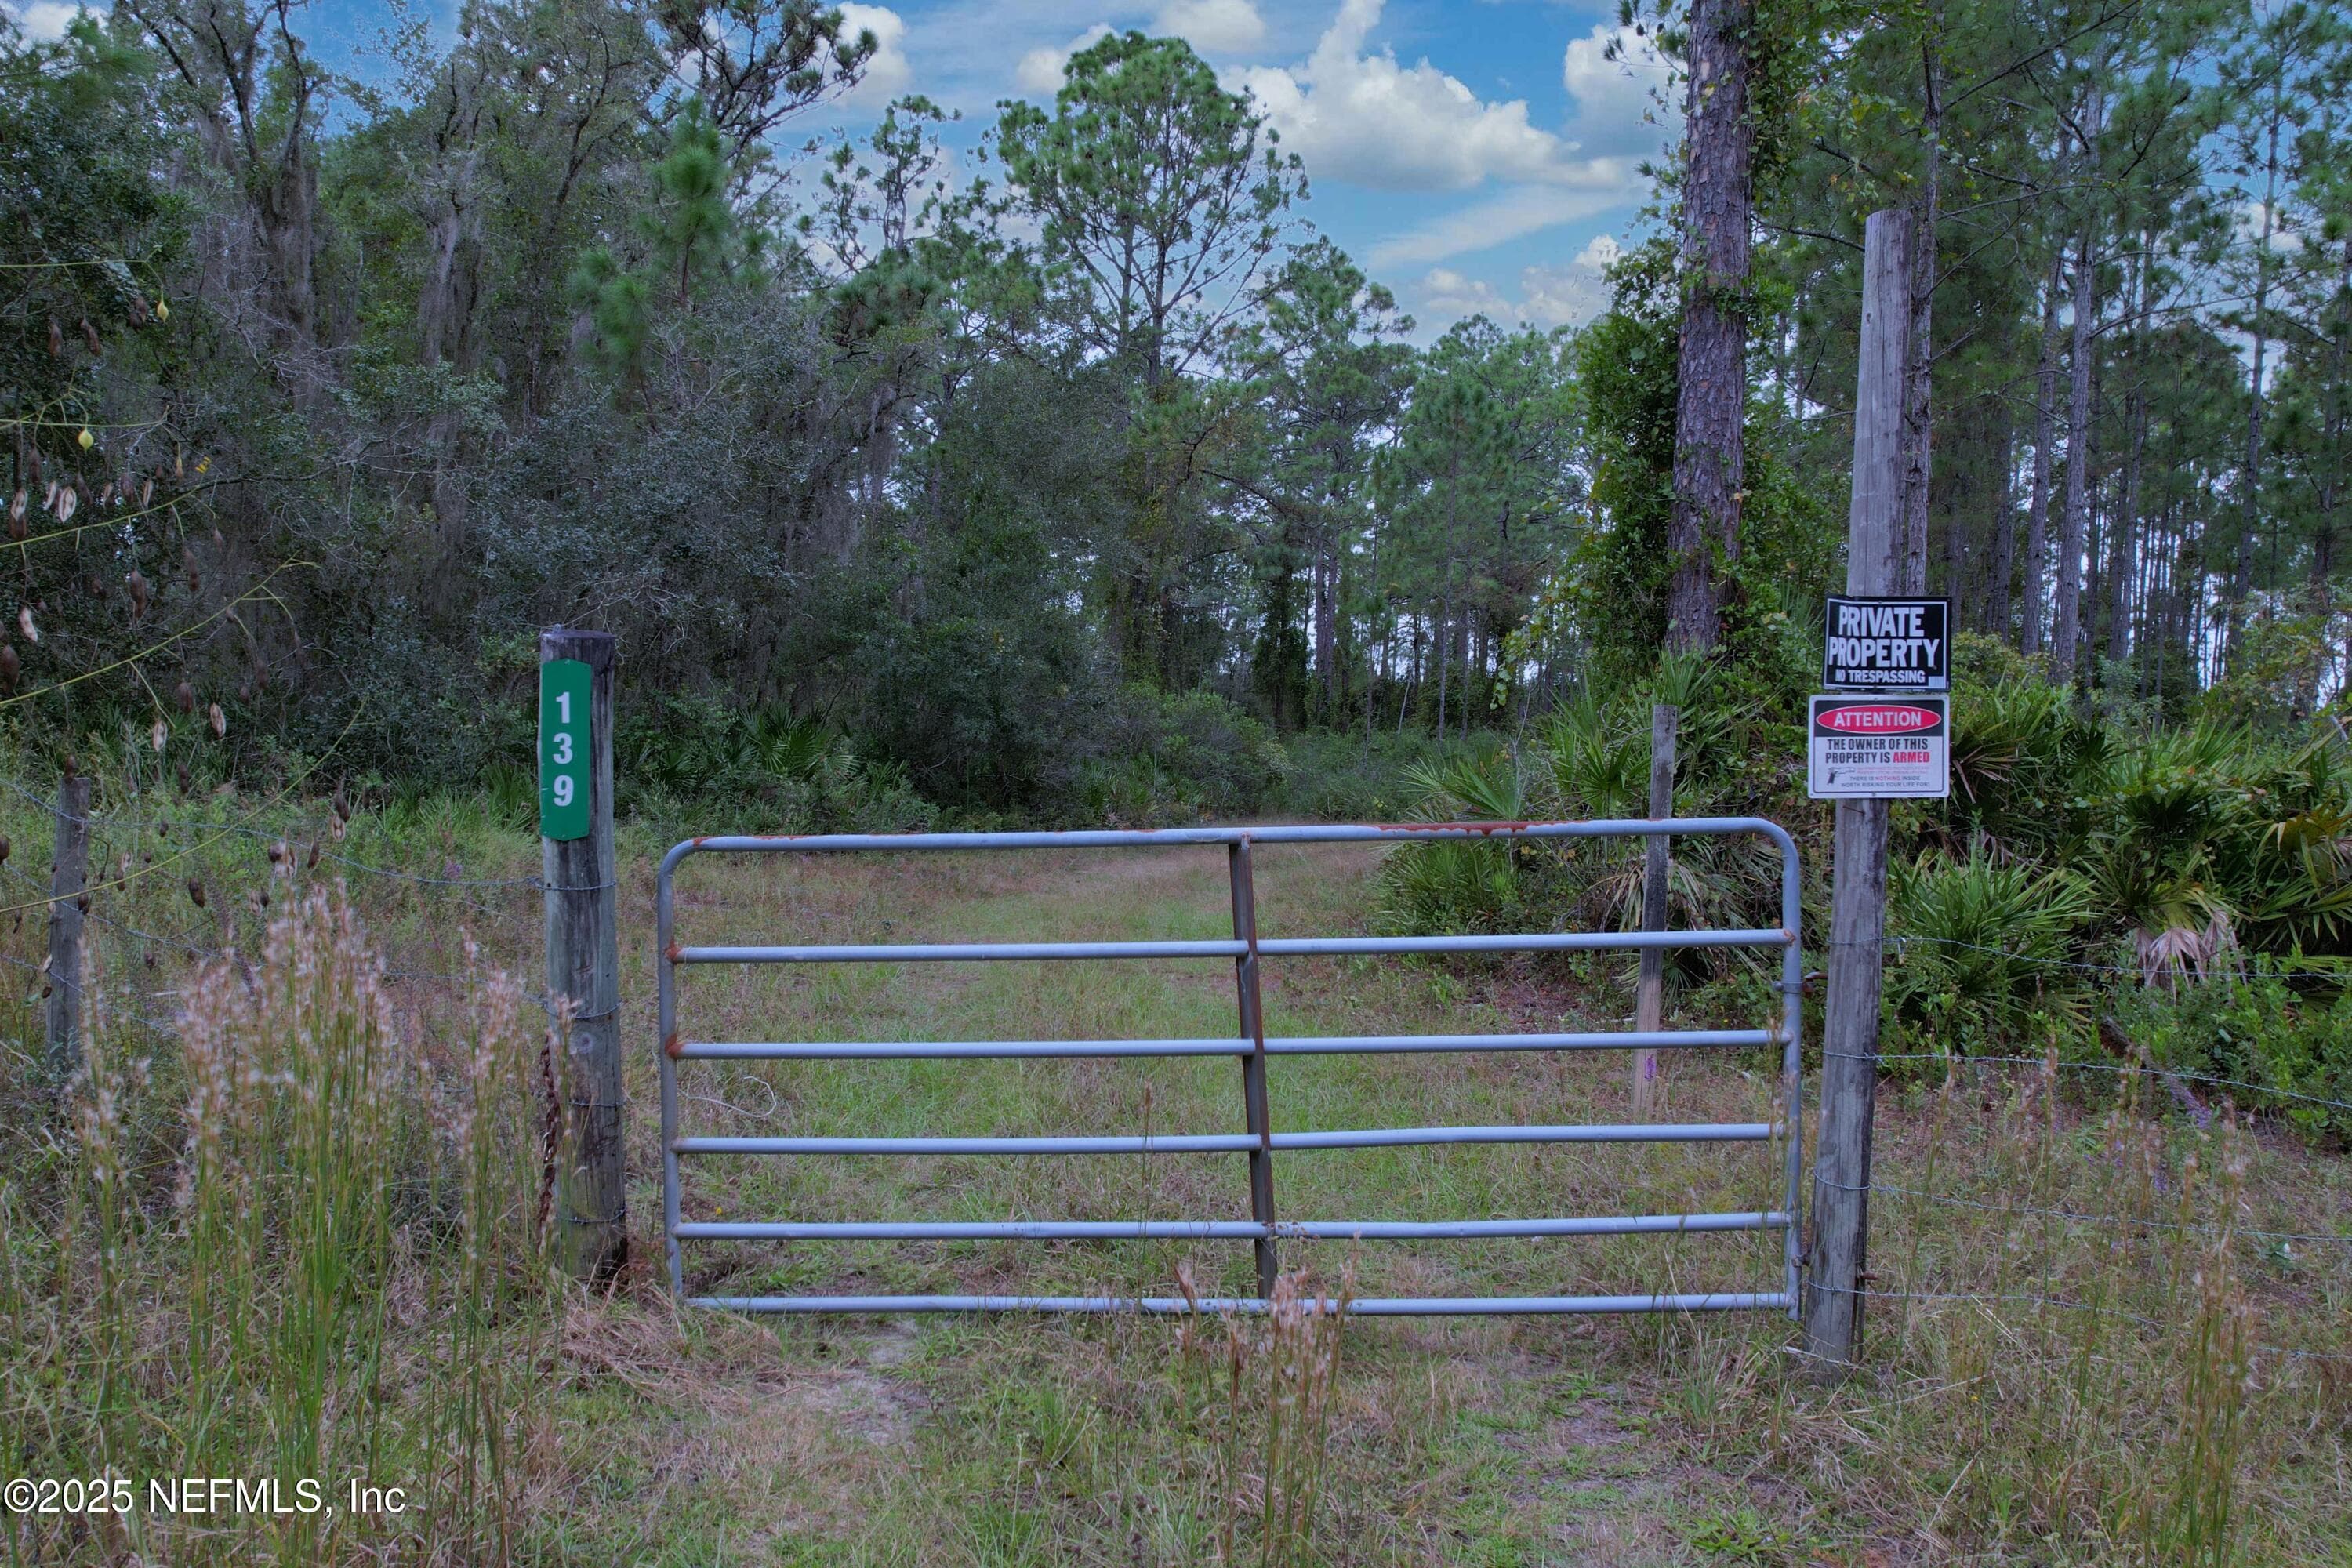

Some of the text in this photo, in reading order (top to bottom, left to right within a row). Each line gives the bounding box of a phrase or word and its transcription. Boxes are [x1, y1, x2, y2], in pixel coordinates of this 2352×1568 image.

[1838, 605, 1925, 637] PRIVATE
[1828, 637, 1940, 667] PROPERTY
[1835, 669, 1926, 683] NO TRESPASSING
[1834, 711, 1921, 727] ATTENTION
[553, 691, 574, 807] 139
[1828, 738, 1928, 750] THE OWNER OF THIS
[1825, 751, 1930, 764] PROPERTY IS ARMED
